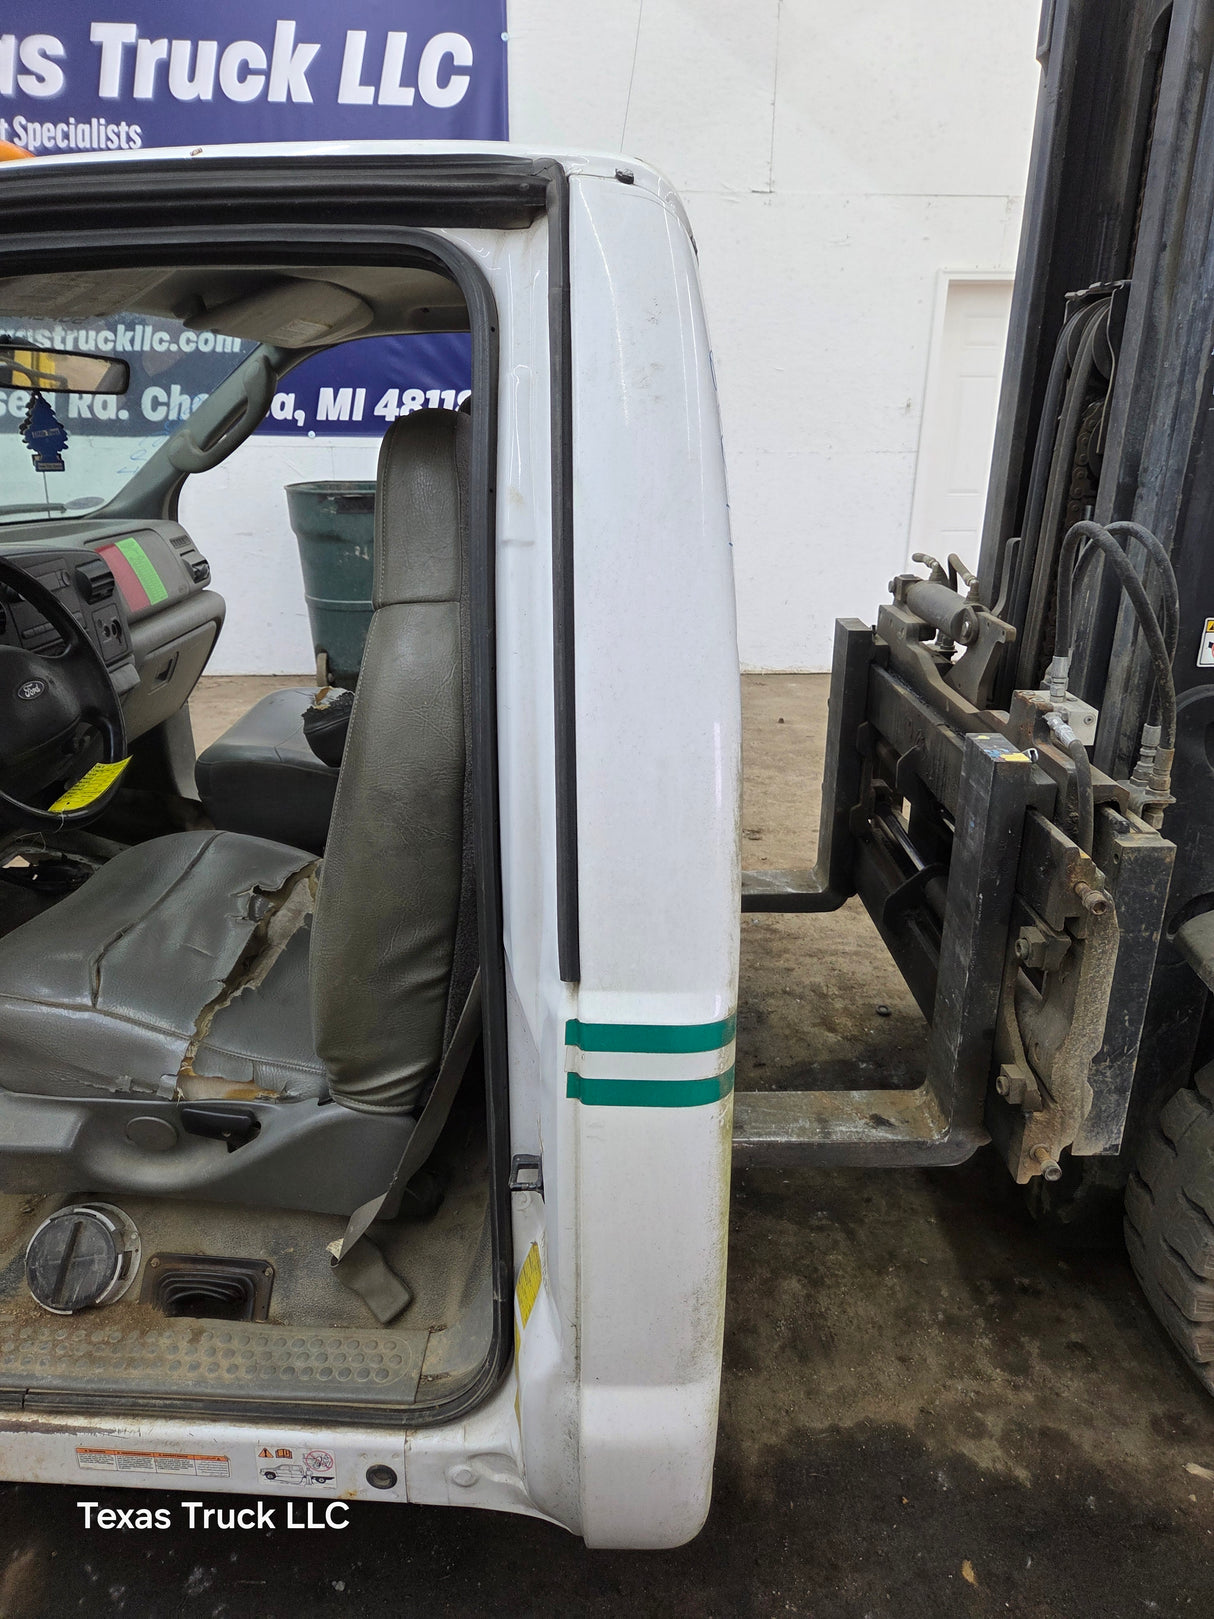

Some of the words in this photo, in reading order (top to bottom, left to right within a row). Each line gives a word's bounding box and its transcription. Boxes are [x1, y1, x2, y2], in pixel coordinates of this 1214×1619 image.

[90, 19, 322, 103] Truck
[338, 30, 473, 108] LLC
[12, 115, 144, 150] Specialists
[317, 387, 366, 421] MI
